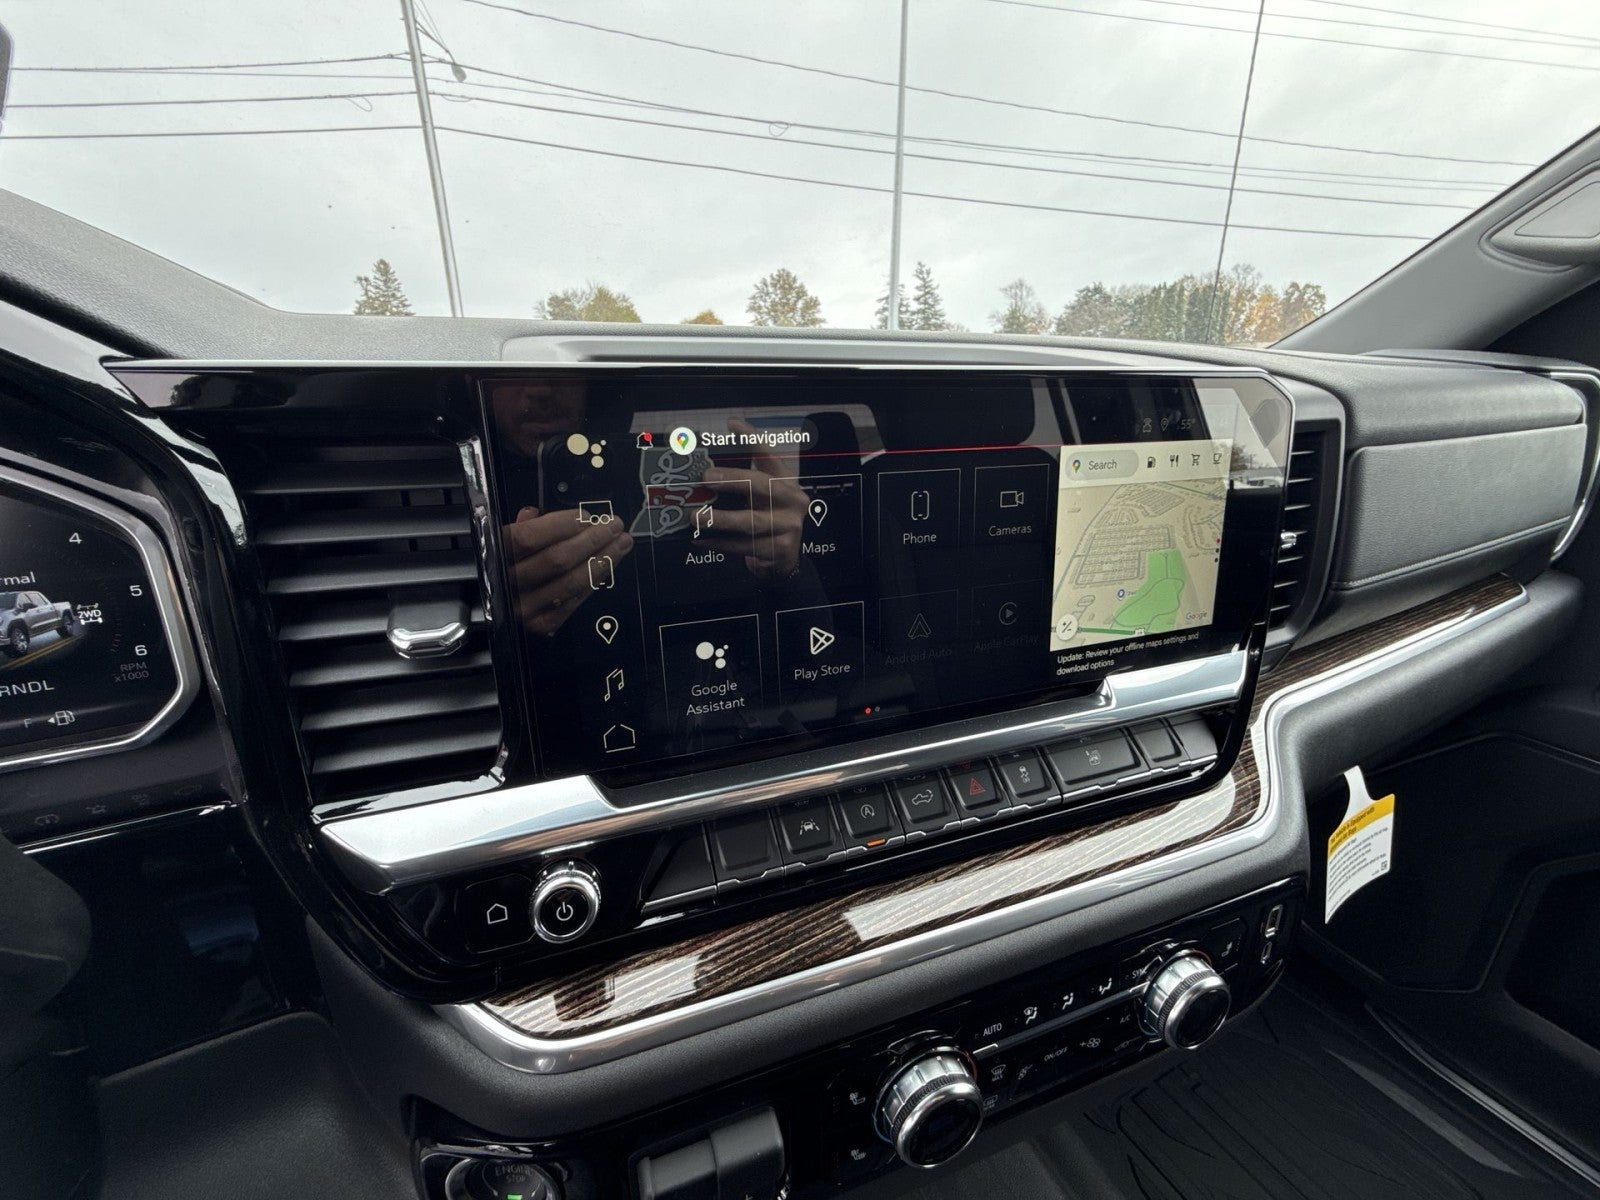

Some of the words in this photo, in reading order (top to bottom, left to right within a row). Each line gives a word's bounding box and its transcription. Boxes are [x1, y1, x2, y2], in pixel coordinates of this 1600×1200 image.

[700, 431, 736, 447] Start
[740, 430, 811, 447] navigation
[1088, 458, 1118, 472] Search
[988, 523, 1033, 538] Cameras
[69, 532, 82, 545] 4
[903, 531, 937, 546] Phone
[802, 541, 836, 556] Maps
[685, 551, 725, 565] Audio
[130, 585, 143, 597] 5
[77, 608, 102, 620] 2WD
[1186, 610, 1208, 621] Google
[135, 645, 148, 657] 6
[1057, 654, 1084, 664] Update:
[1086, 650, 1108, 660] Review
[1109, 647, 1123, 656] your
[1125, 642, 1144, 652] offline
[1146, 639, 1162, 649] maps
[1163, 635, 1187, 646] settings
[1188, 632, 1199, 641] and
[885, 652, 925, 666] Android
[928, 648, 952, 660] Auto
[120, 662, 147, 672] RPM
[794, 669, 817, 682] Play
[821, 662, 851, 676] Store
[1056, 662, 1089, 676] download
[1090, 658, 1115, 670] options
[114, 670, 149, 683] x1000
[691, 680, 737, 697] Google
[686, 696, 745, 716] Assistant
[24, 717, 33, 728] F
[983, 1022, 1003, 1037] AUTO
